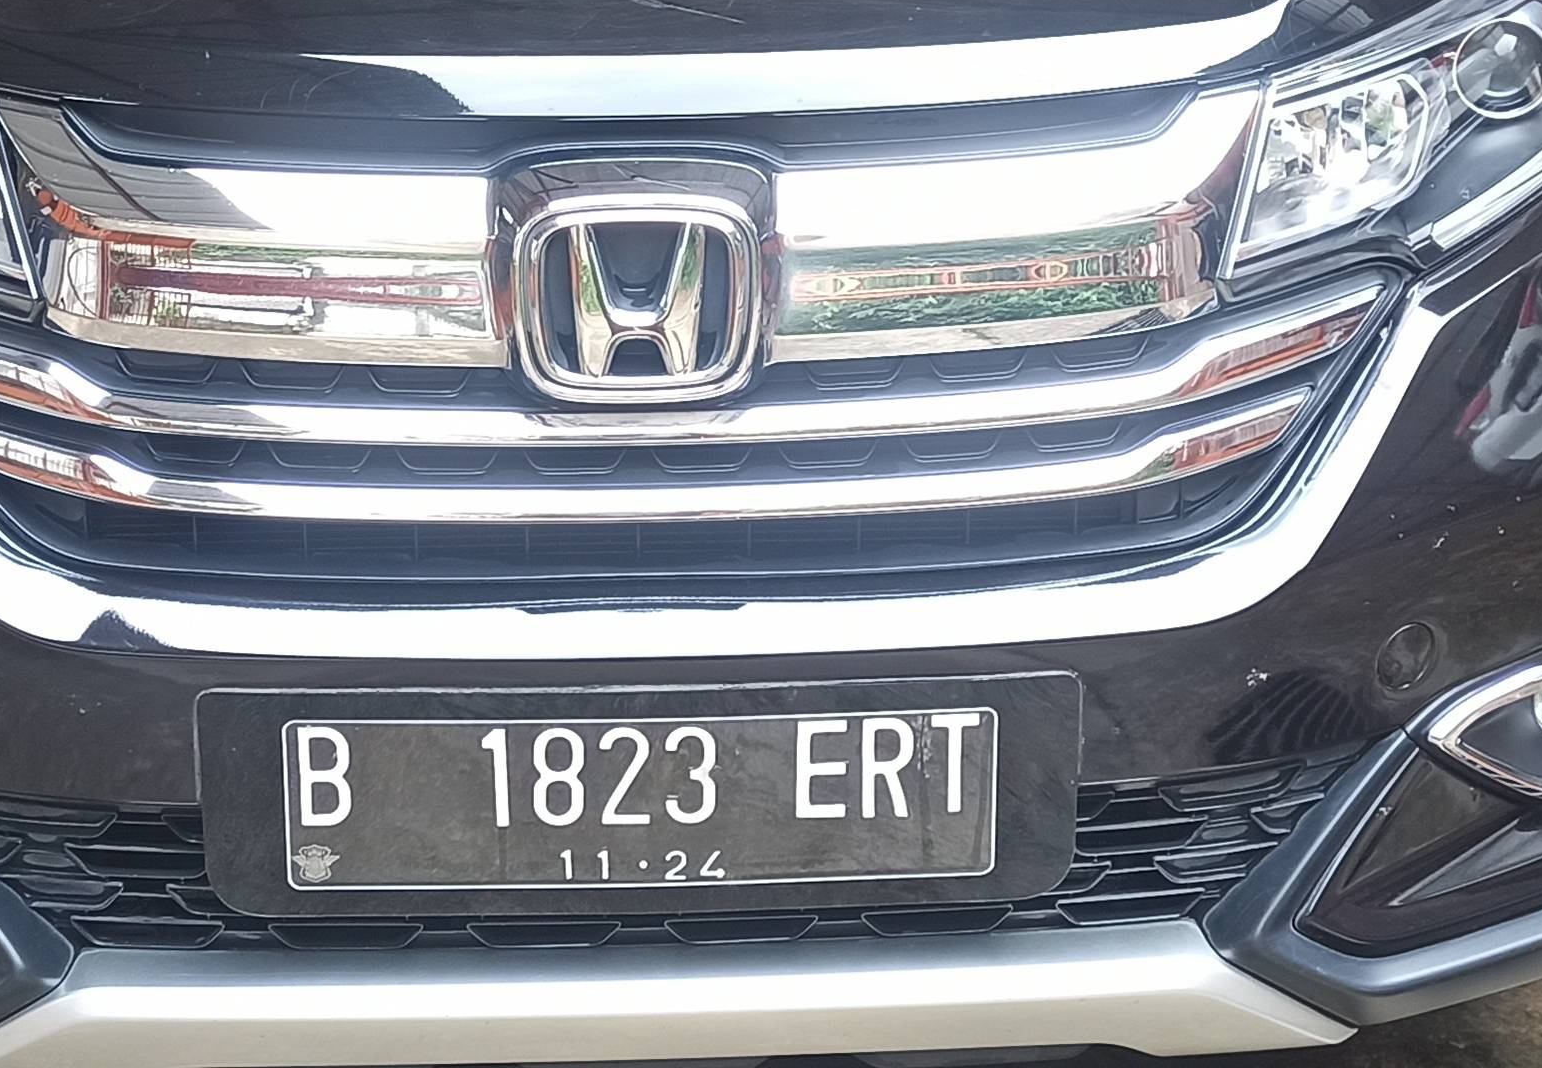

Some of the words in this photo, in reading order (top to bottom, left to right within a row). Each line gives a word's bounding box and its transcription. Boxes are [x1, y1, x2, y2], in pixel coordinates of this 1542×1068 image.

[296, 724, 353, 828] B
[481, 725, 718, 828] 1823
[795, 712, 981, 820] ERT
